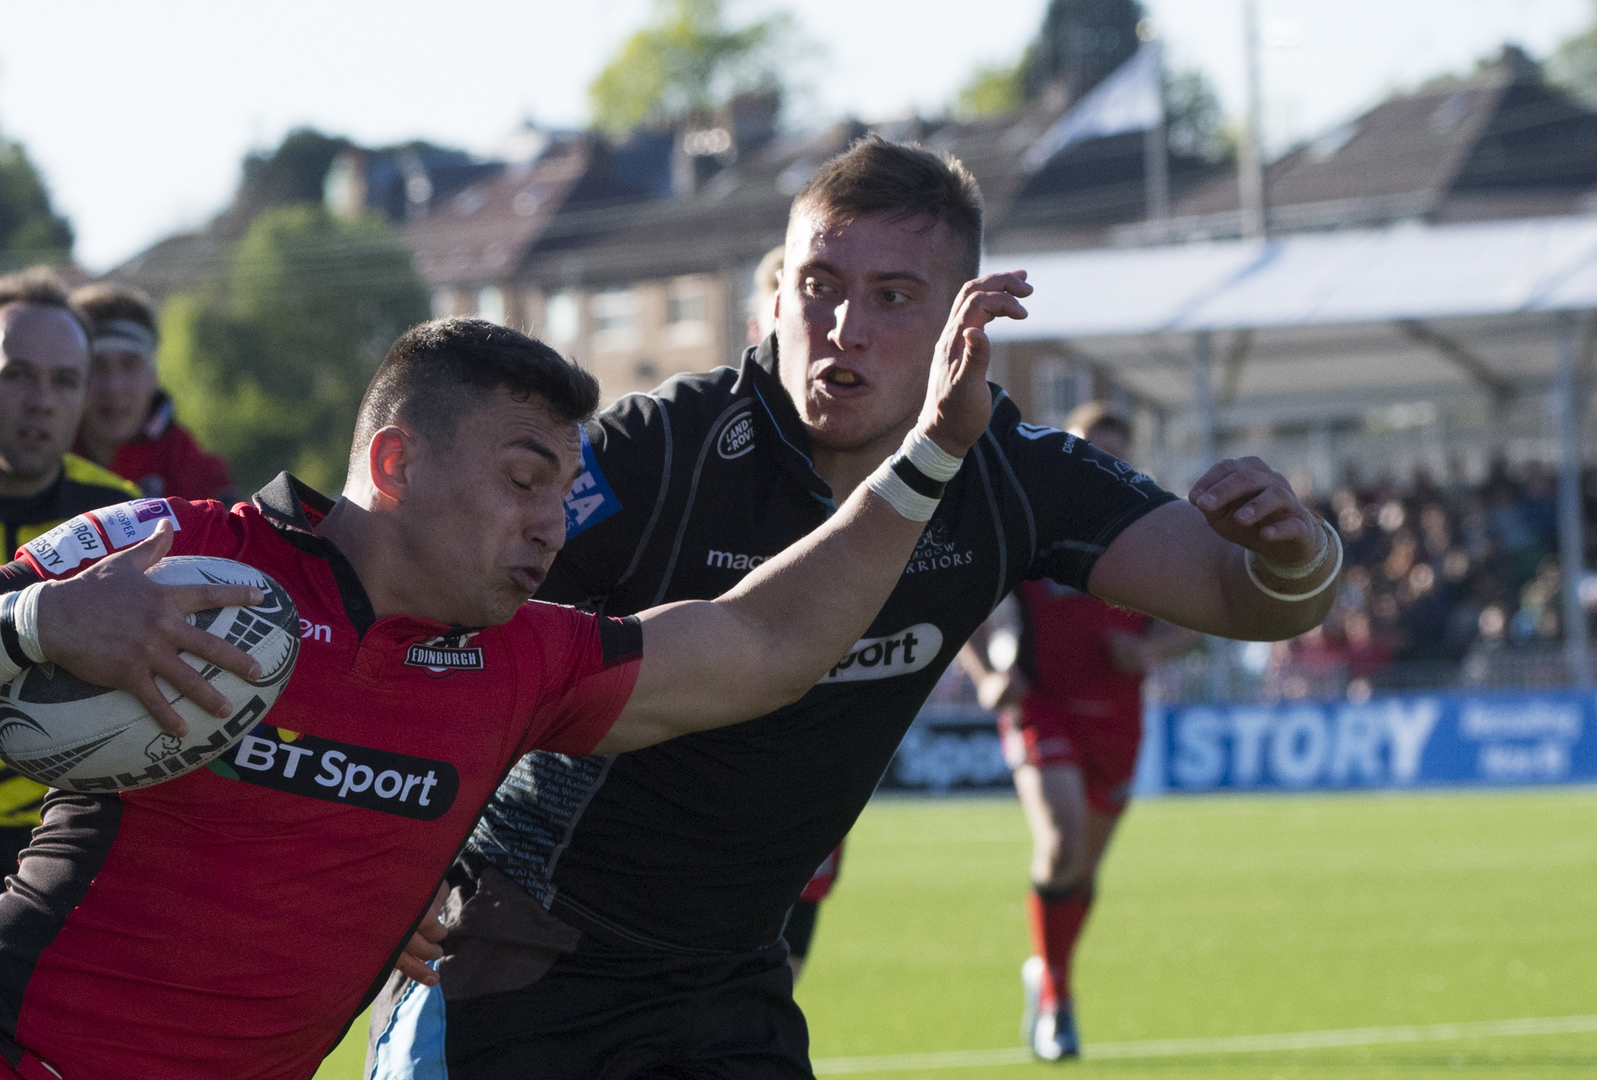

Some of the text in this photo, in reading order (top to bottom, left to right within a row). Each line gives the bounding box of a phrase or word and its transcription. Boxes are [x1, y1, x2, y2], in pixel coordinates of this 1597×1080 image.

[905, 549, 973, 575] RRIORS
[411, 647, 477, 667] EDINBURGH
[1176, 700, 1440, 784] STORY
[234, 734, 314, 778] BT
[314, 749, 439, 807] Sport
